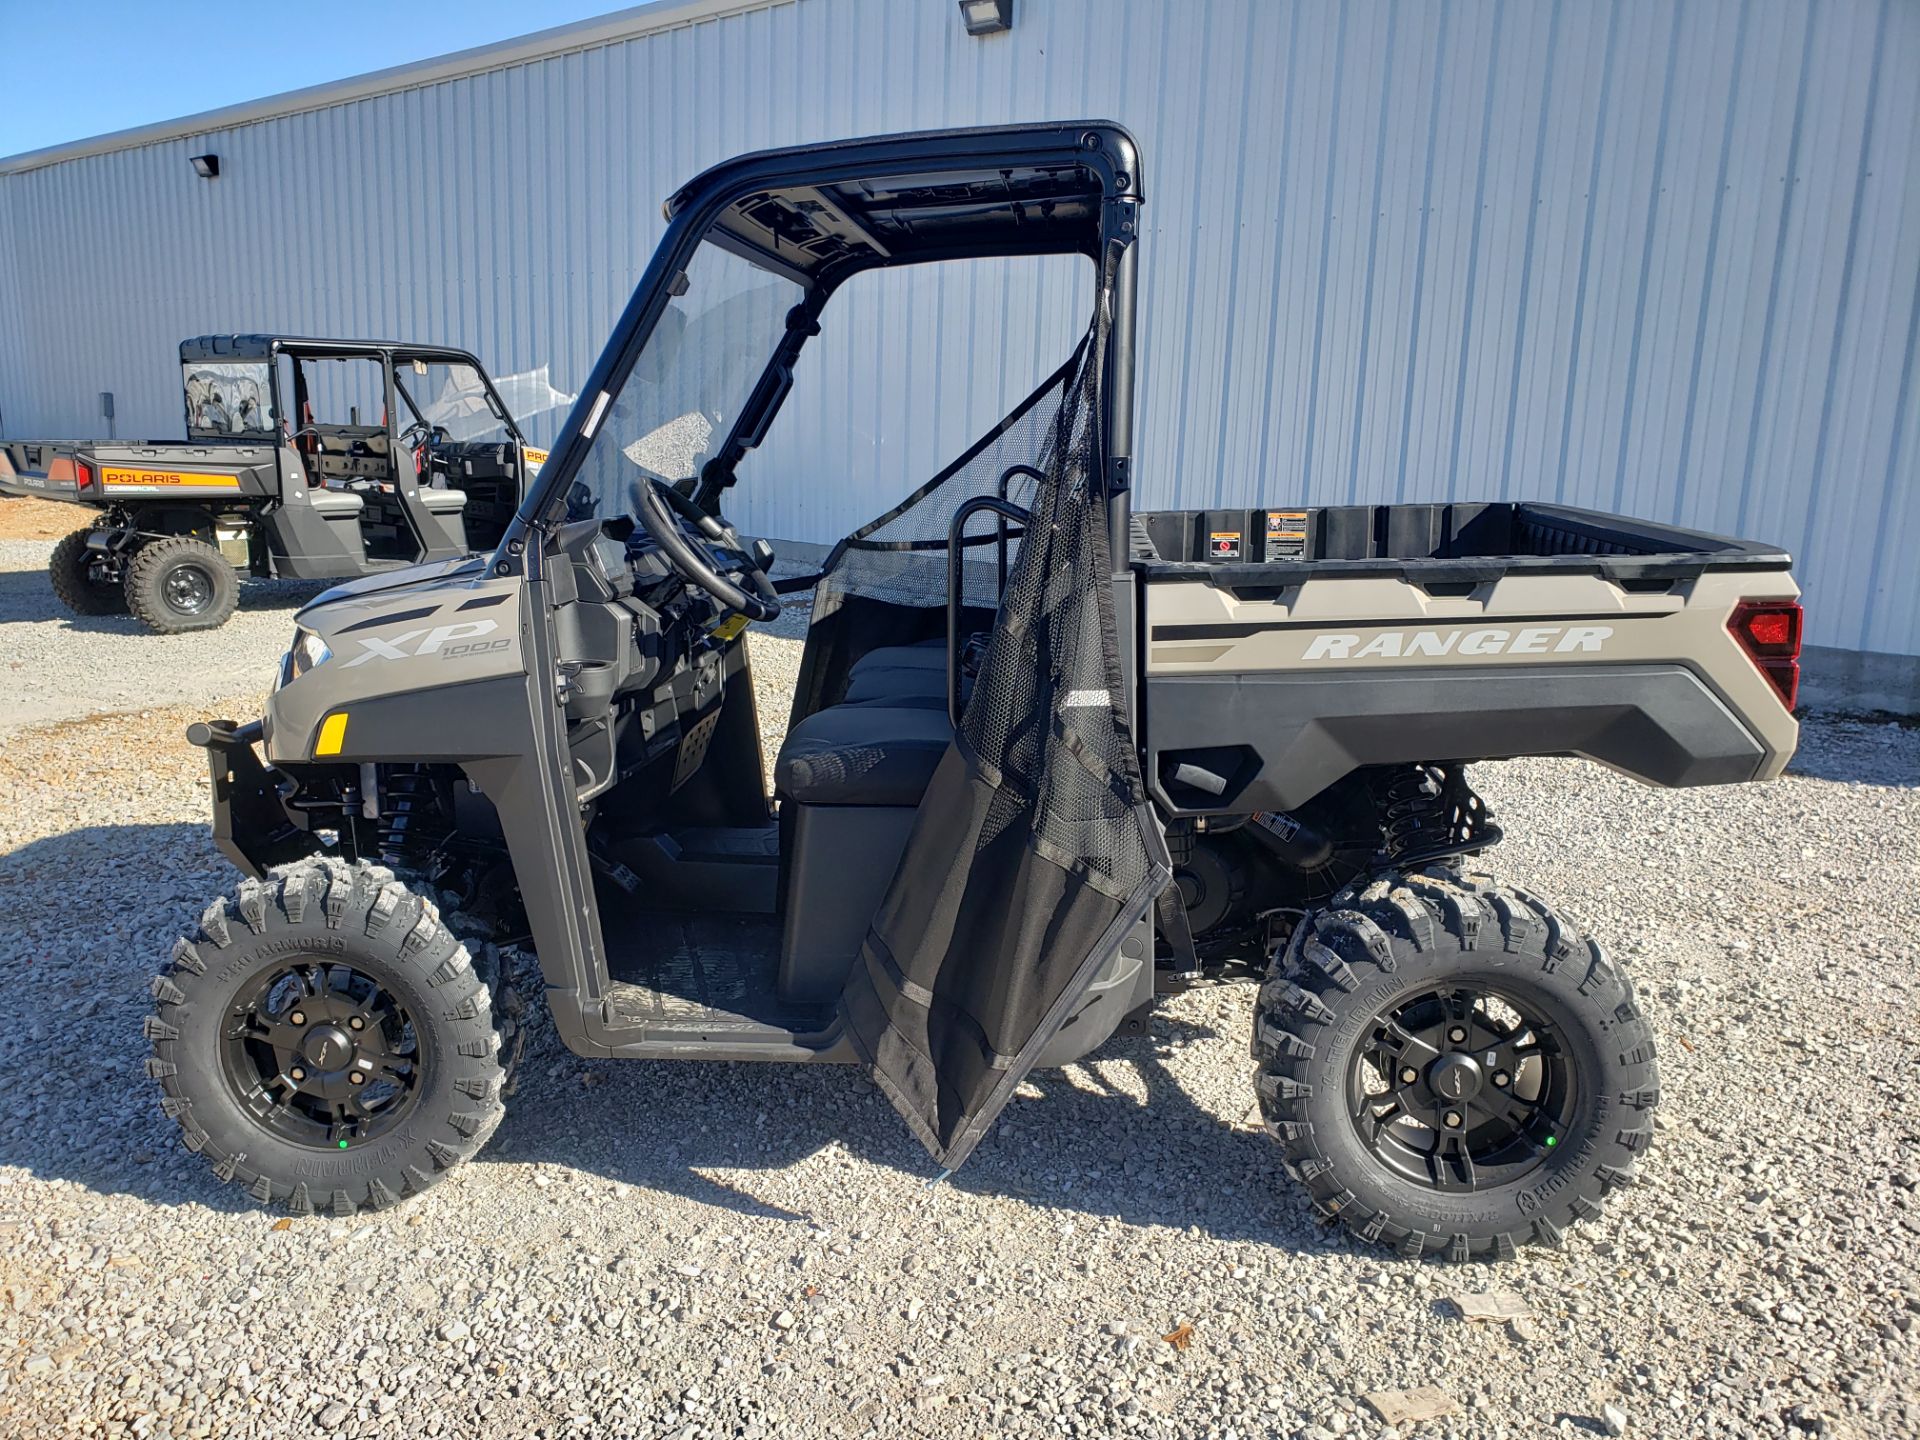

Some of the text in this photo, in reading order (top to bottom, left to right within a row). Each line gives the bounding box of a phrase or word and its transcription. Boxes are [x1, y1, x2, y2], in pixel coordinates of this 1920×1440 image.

[23, 477, 45, 488] POLARIS
[106, 473, 181, 484] POLARIS
[337, 619, 512, 670] XP 1000
[1301, 626, 1615, 660] RANGER
